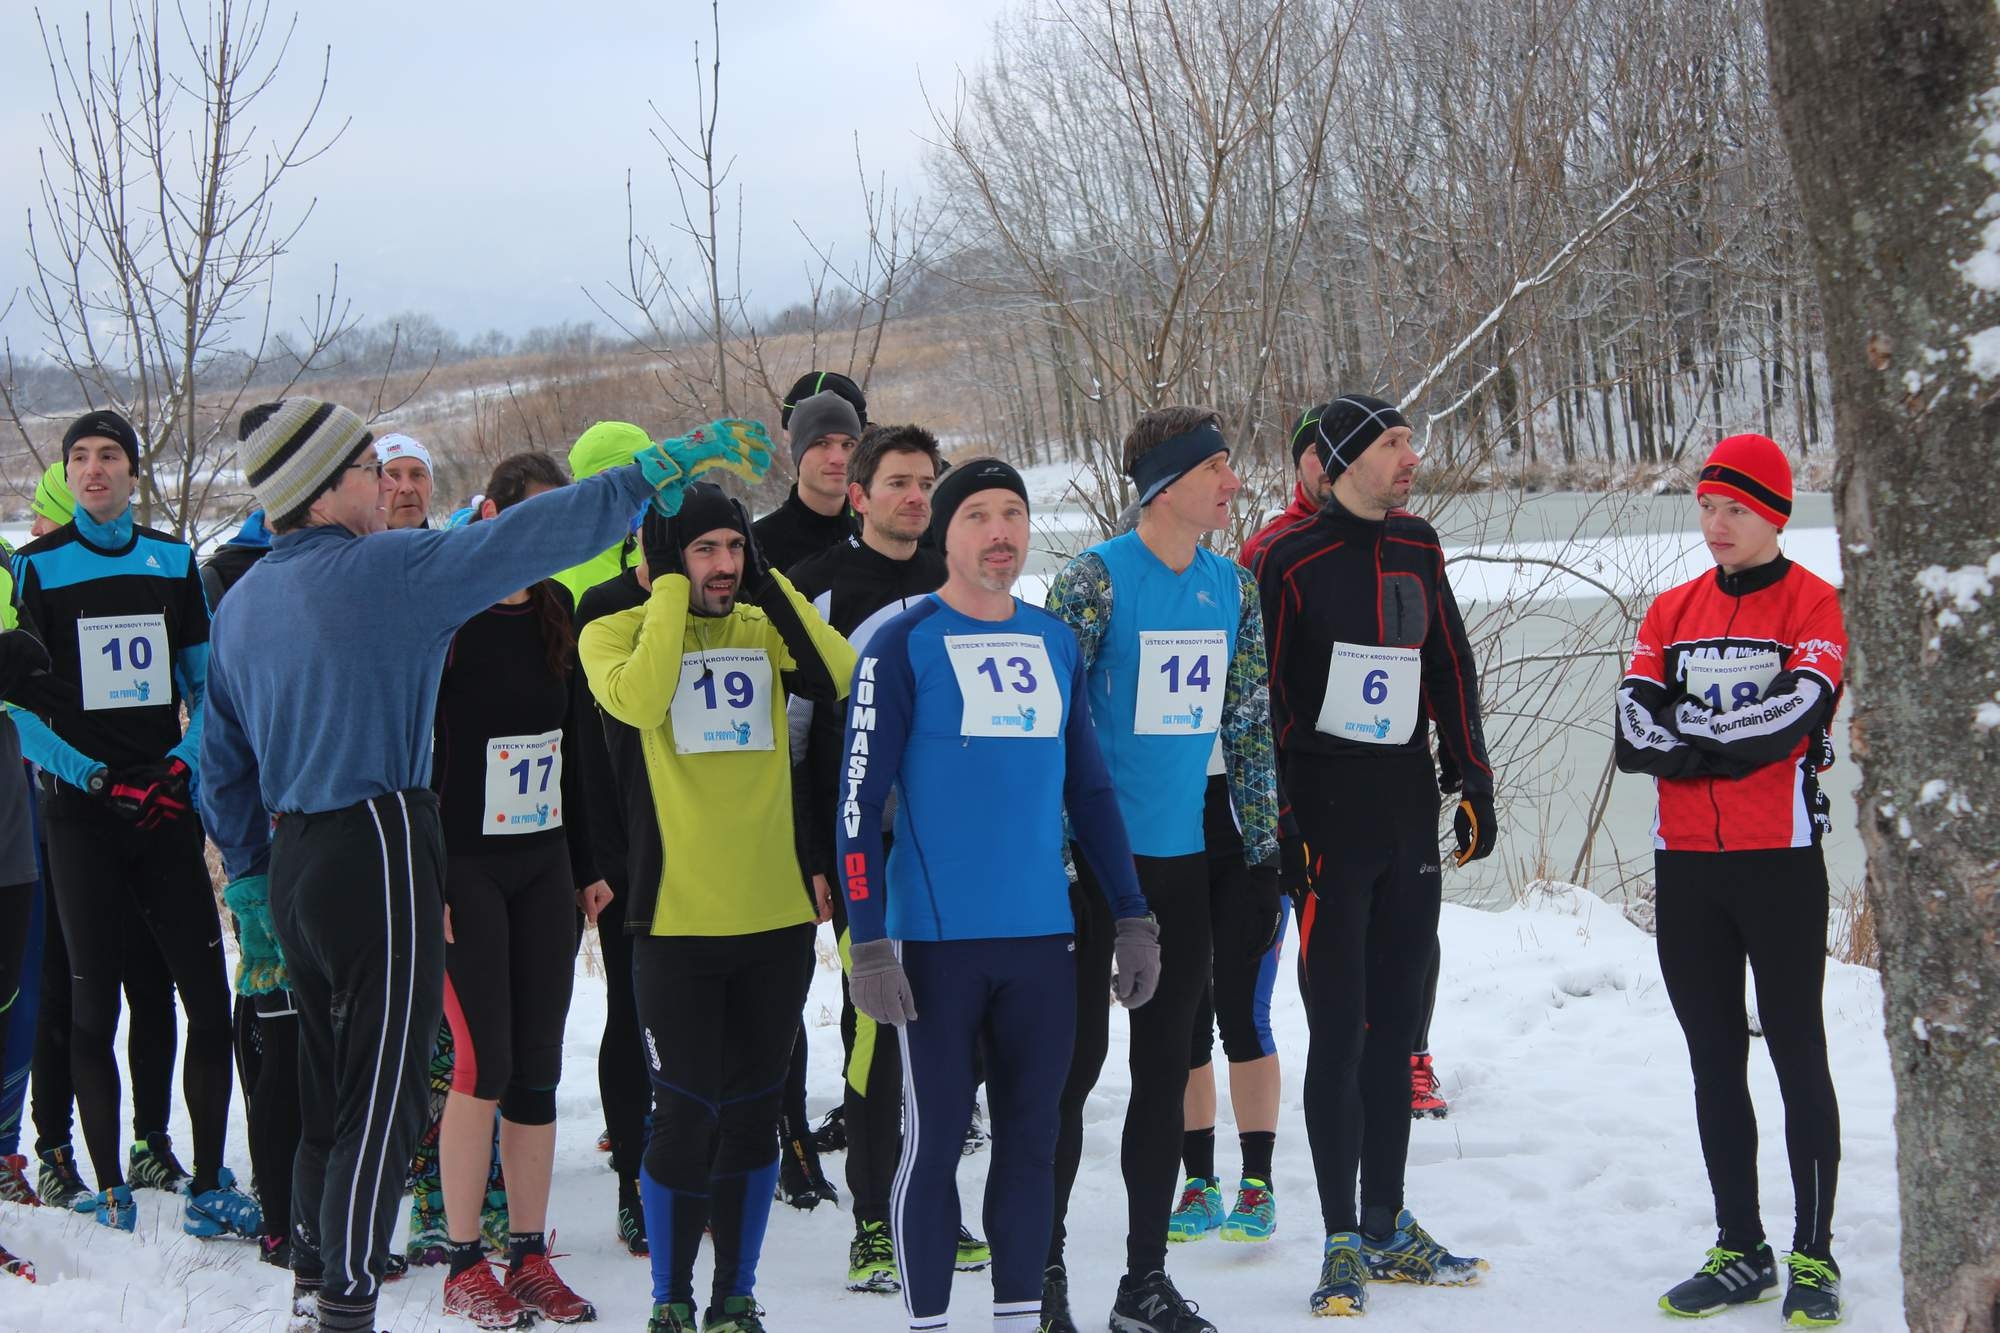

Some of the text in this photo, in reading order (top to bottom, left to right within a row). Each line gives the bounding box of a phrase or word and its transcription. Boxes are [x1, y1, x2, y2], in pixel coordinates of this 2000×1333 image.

[102, 636, 152, 671] 10
[693, 671, 754, 709] 19
[977, 657, 1037, 693] 13
[1161, 655, 1210, 692] 14
[1362, 669, 1389, 705] 6
[1704, 681, 1759, 711] 18
[1710, 713, 1763, 735] Mountain
[1763, 696, 1804, 722] Bikers
[843, 657, 879, 838] KOMASTAV
[510, 755, 553, 794] 17
[845, 852, 869, 901] DS
